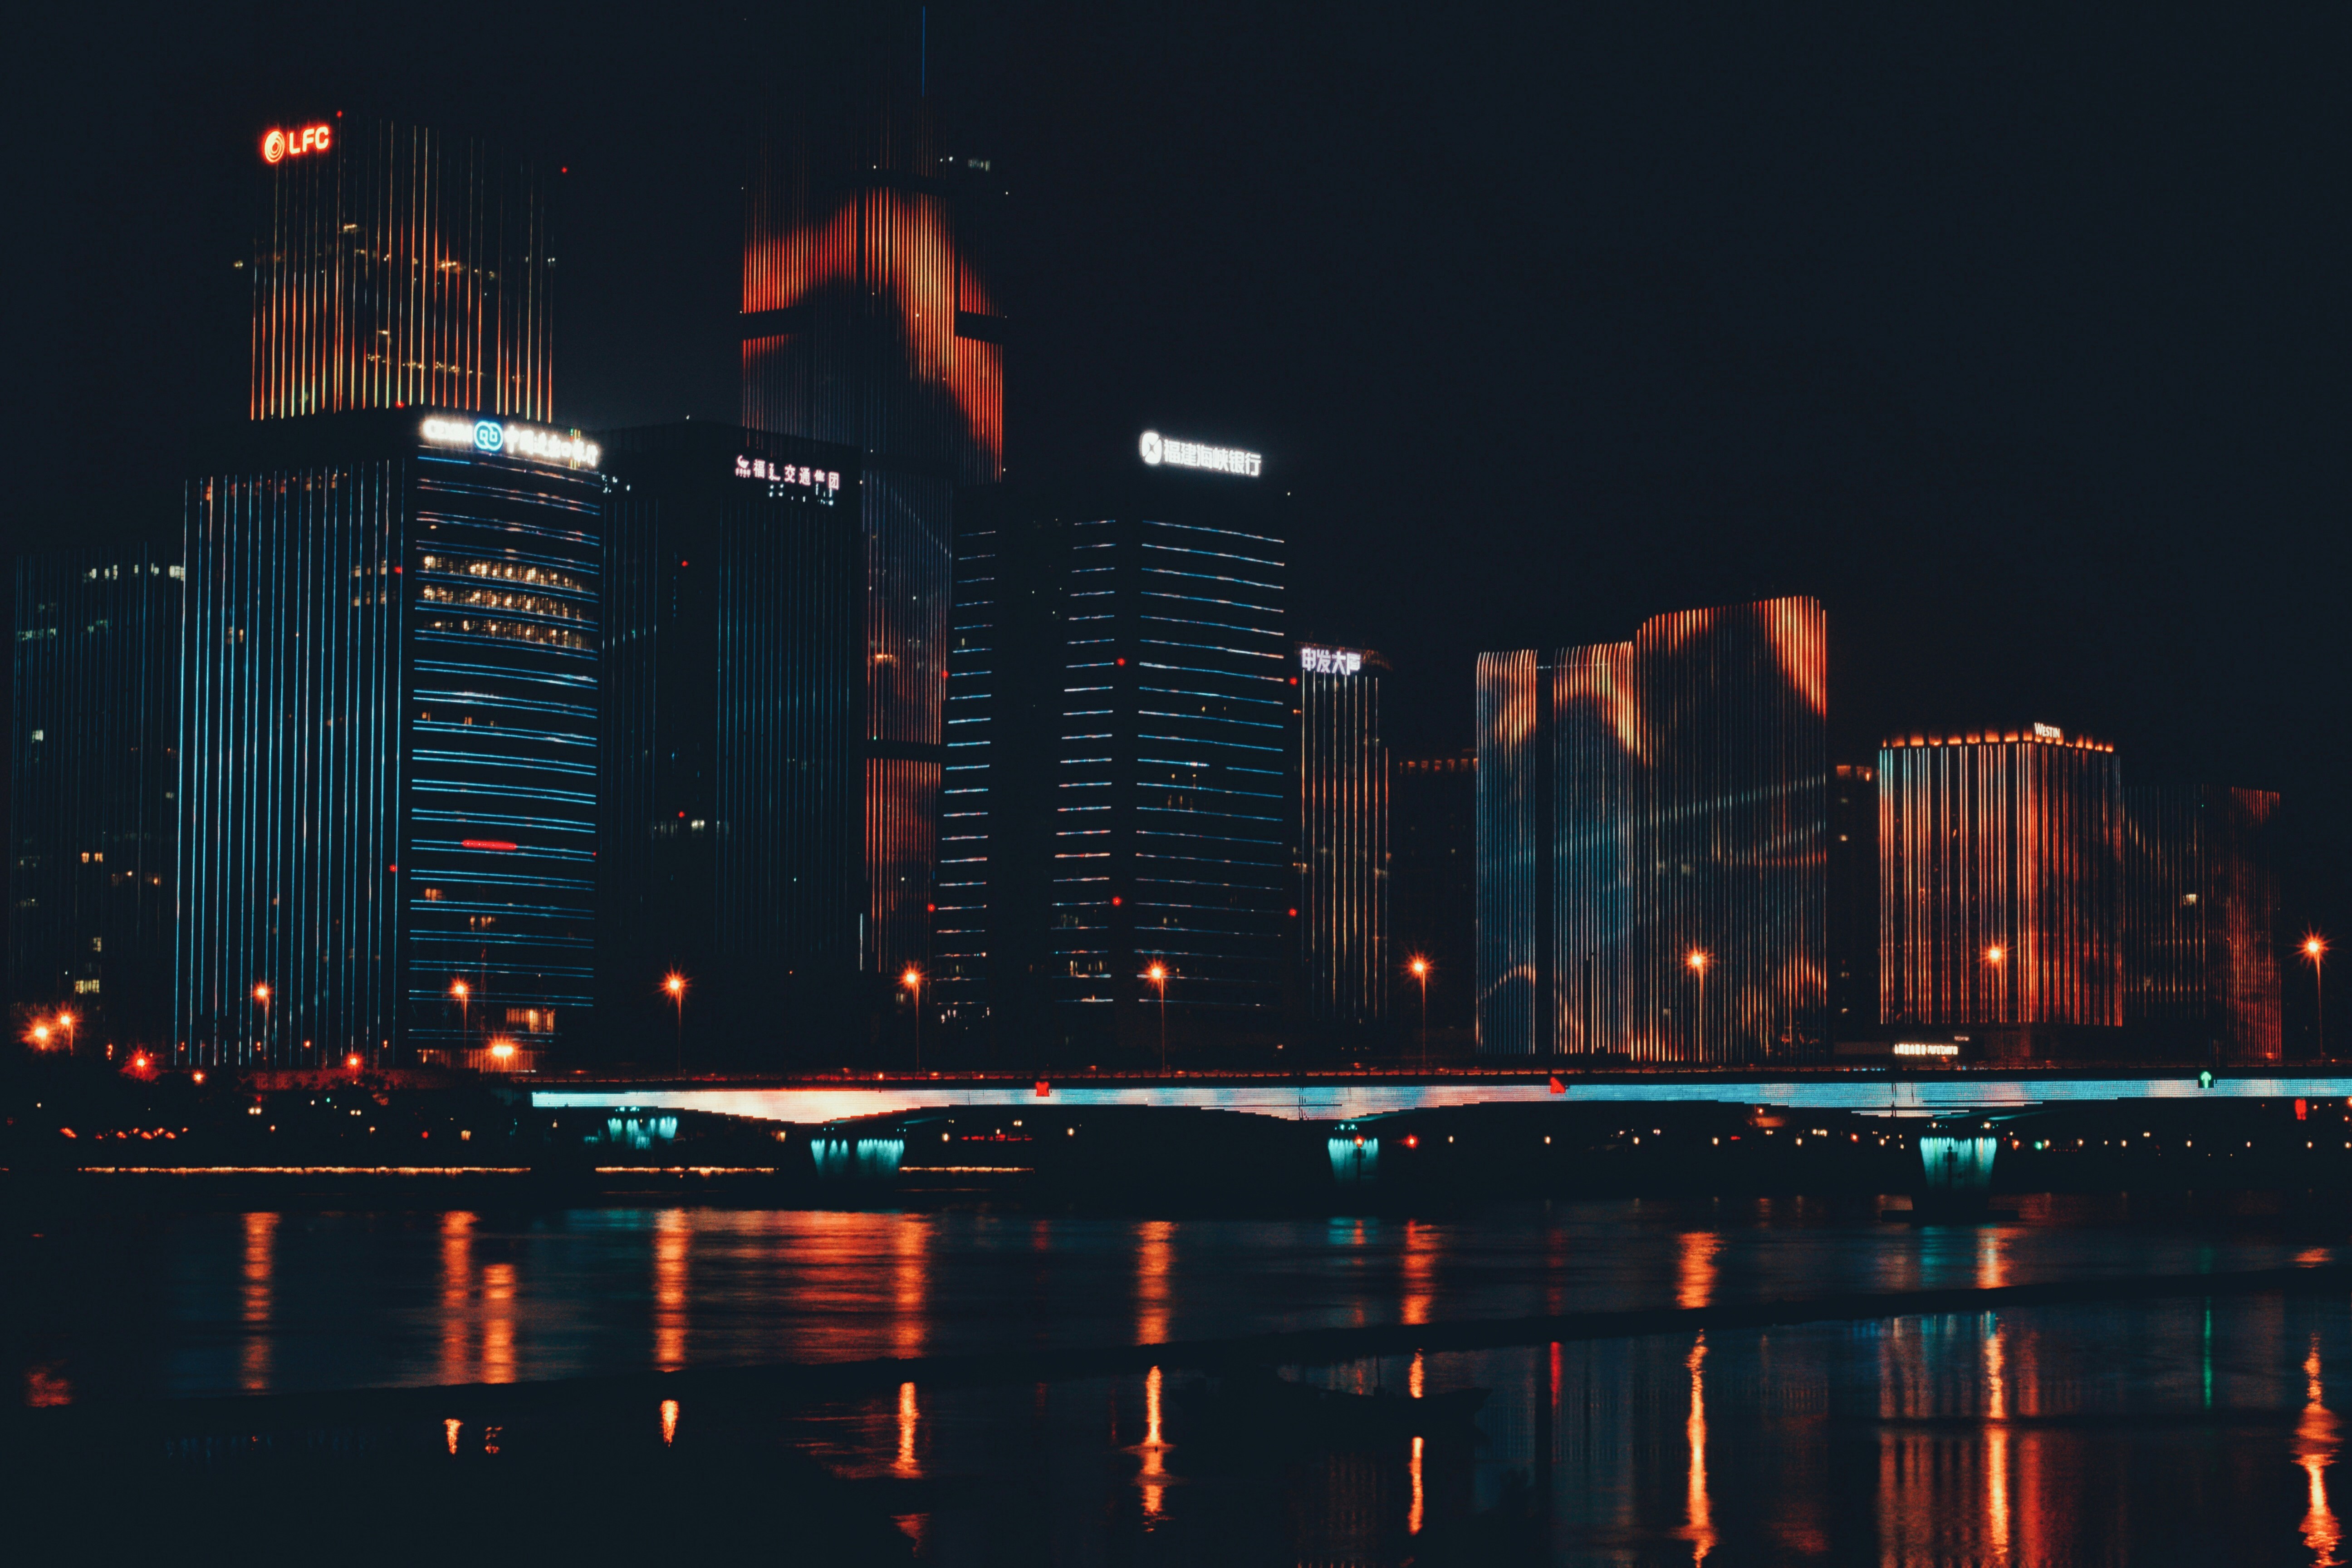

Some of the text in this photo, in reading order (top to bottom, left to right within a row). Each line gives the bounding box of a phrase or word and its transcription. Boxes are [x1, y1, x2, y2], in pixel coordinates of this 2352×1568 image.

[289, 126, 329, 154] LFC
[1164, 439, 1261, 476] 福建海峡银行
[2034, 722, 2060, 739] WESTIN
